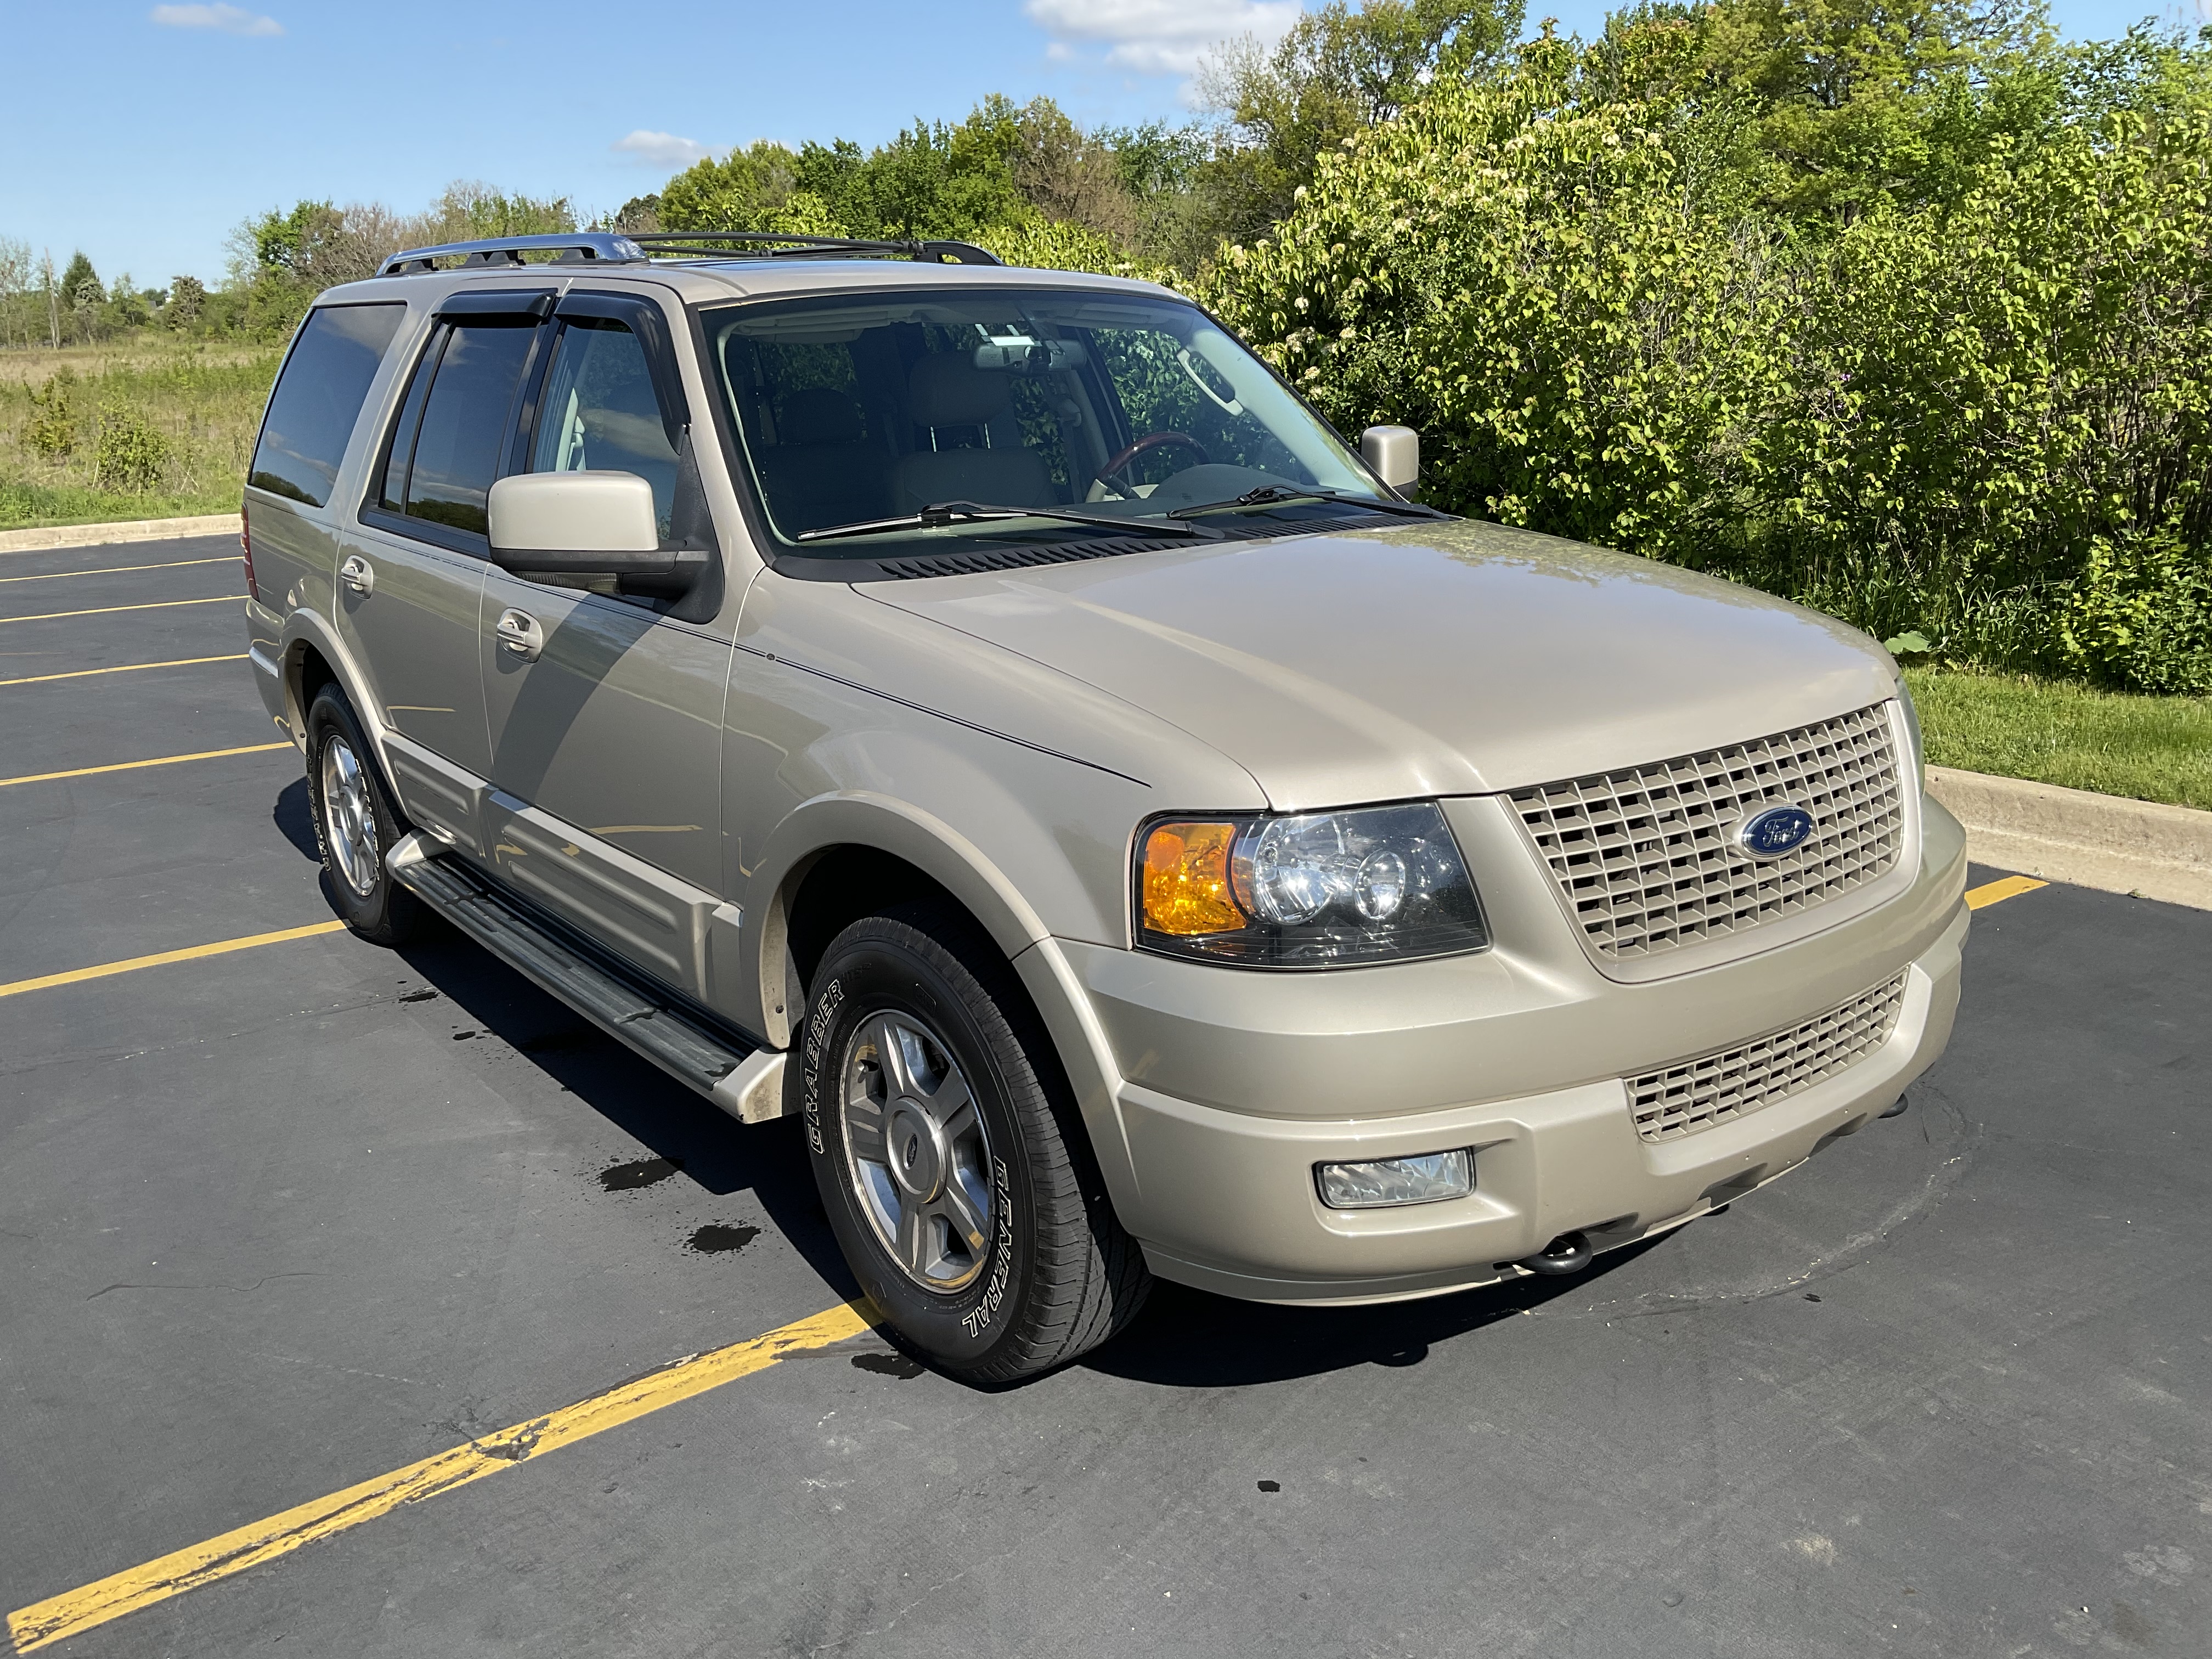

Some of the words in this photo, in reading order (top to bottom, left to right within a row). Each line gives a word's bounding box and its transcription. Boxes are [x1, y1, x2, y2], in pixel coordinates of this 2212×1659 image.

[1762, 816, 1802, 847] Ford
[805, 978, 845, 1155] GRABBER
[962, 1155, 1012, 1339] GENERAL
